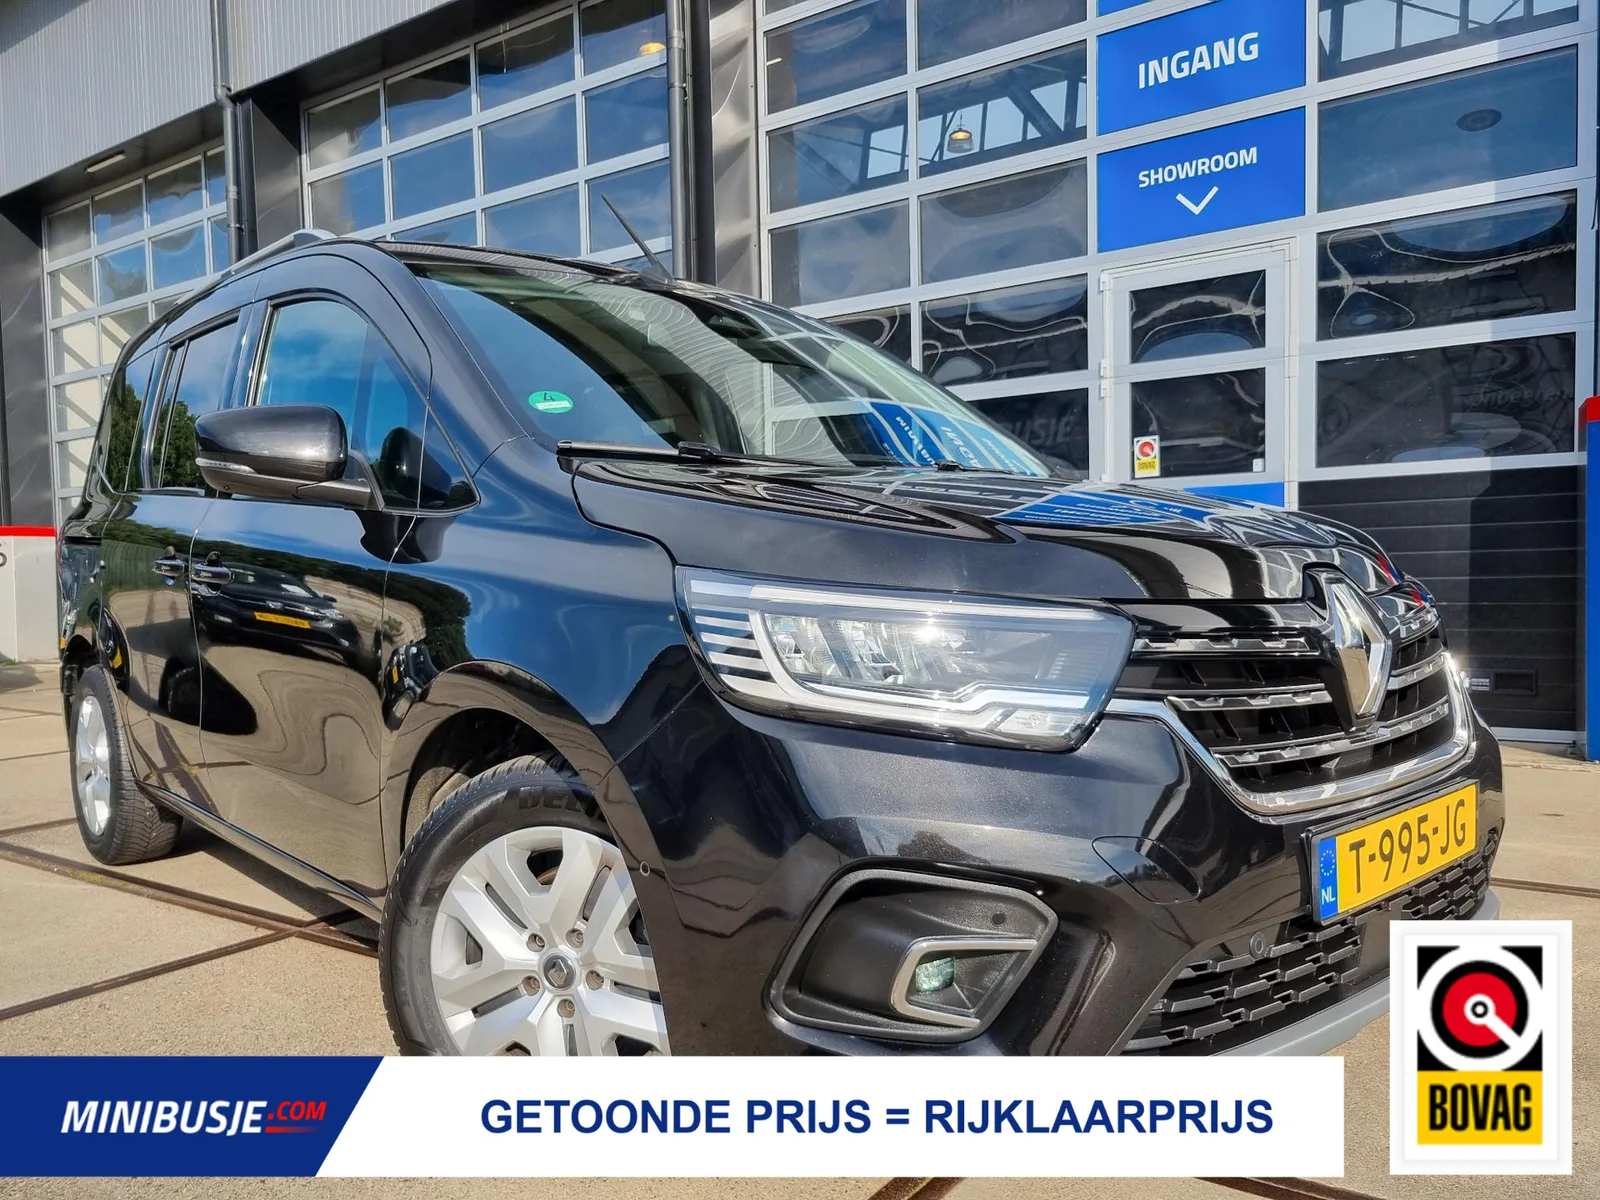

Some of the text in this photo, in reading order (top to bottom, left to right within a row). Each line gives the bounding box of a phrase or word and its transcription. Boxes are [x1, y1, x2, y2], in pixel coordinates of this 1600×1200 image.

[1138, 32, 1259, 90] INGANG
[1138, 146, 1258, 189] SHOWROOM
[1348, 798, 1466, 894] T-995-JG
[1321, 885, 1336, 905] NL
